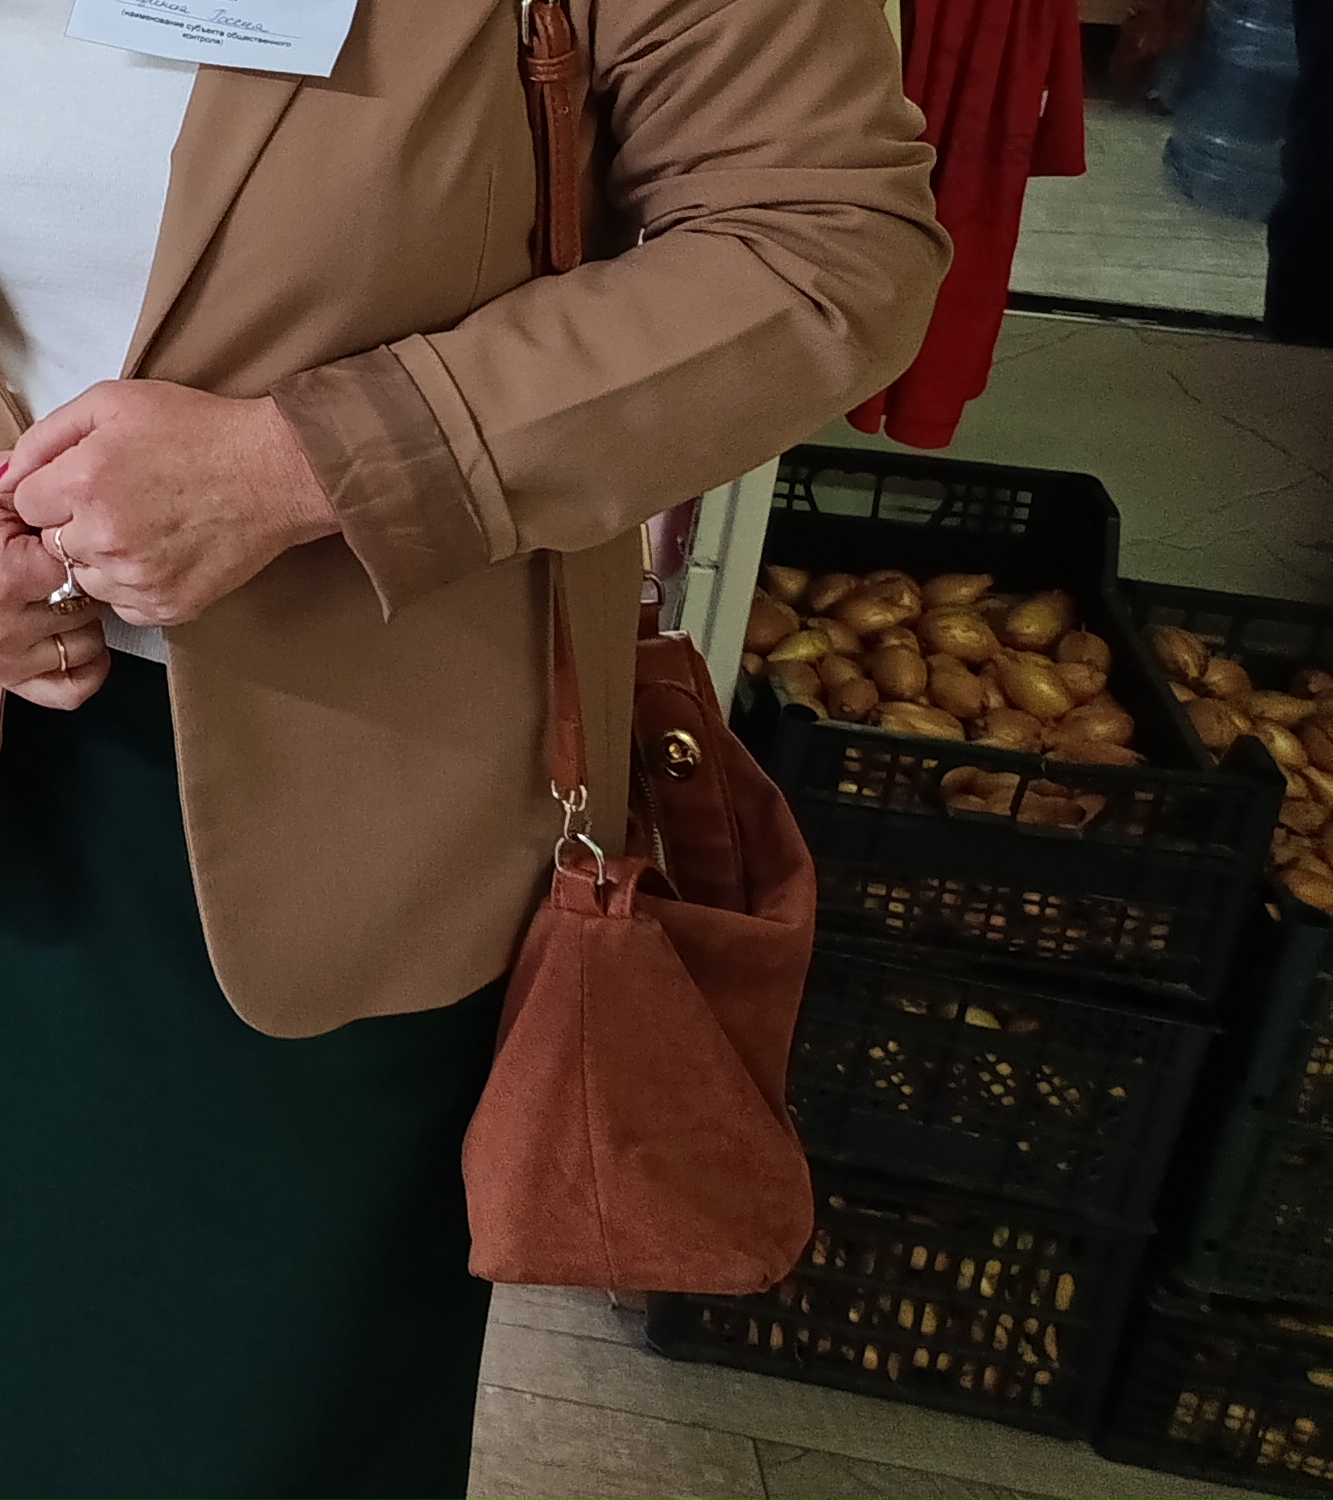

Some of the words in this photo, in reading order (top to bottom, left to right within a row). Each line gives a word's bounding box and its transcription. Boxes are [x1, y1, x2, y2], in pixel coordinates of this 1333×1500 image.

[121, 8, 185, 29] (наименование
[186, 23, 225, 38] субъекта
[226, 31, 292, 48] общественного
[182, 33, 224, 47] контроля)
